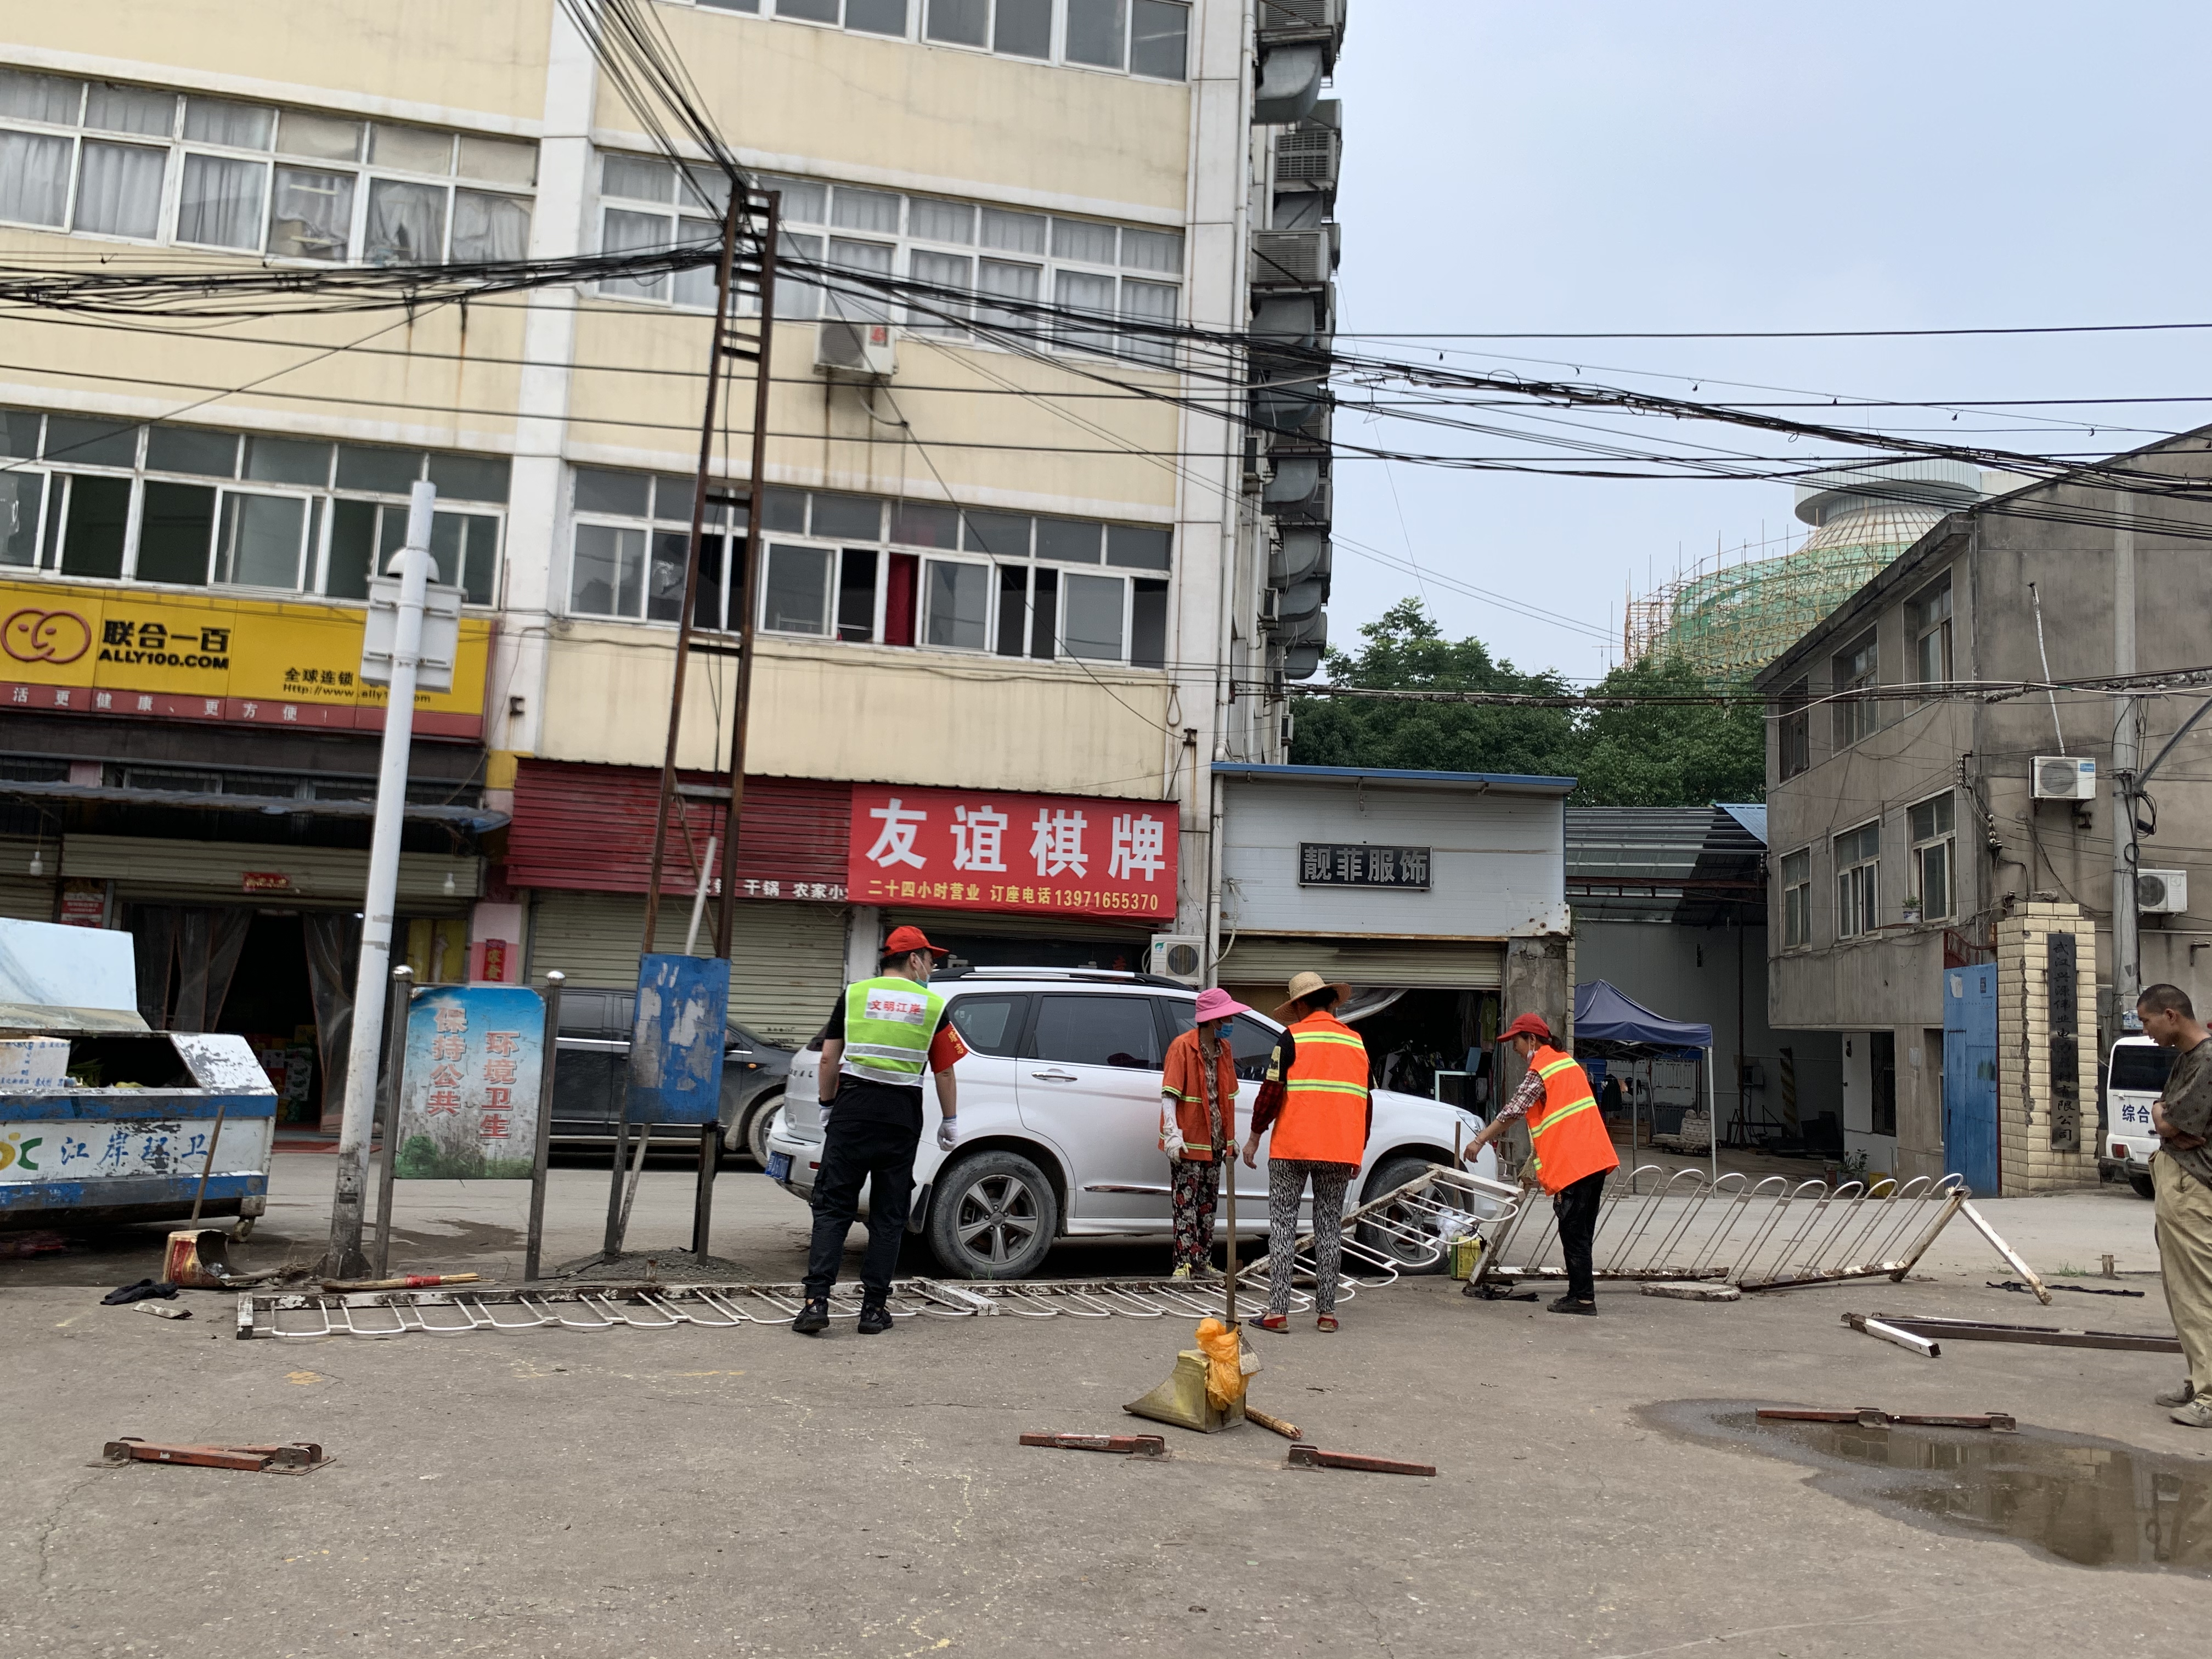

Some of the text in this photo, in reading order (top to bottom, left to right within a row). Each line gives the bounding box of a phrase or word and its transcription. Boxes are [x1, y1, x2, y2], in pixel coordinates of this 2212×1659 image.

[103, 619, 230, 653] 联合一百
[99, 649, 229, 670] ALLY100.COM
[285, 668, 354, 686] 全球连锁
[865, 797, 1165, 882] 友谊棋牌
[1304, 846, 1427, 884] 靓菲服饰
[743, 879, 780, 896] 干锅
[793, 882, 849, 900] 农家小
[868, 879, 980, 901] 二十四小时营业
[870, 1000, 921, 1015] 文明江岸
[426, 1007, 469, 1117] 保持公共
[479, 1030, 521, 1139] 环境卫生
[2122, 1104, 2150, 1124] 综合
